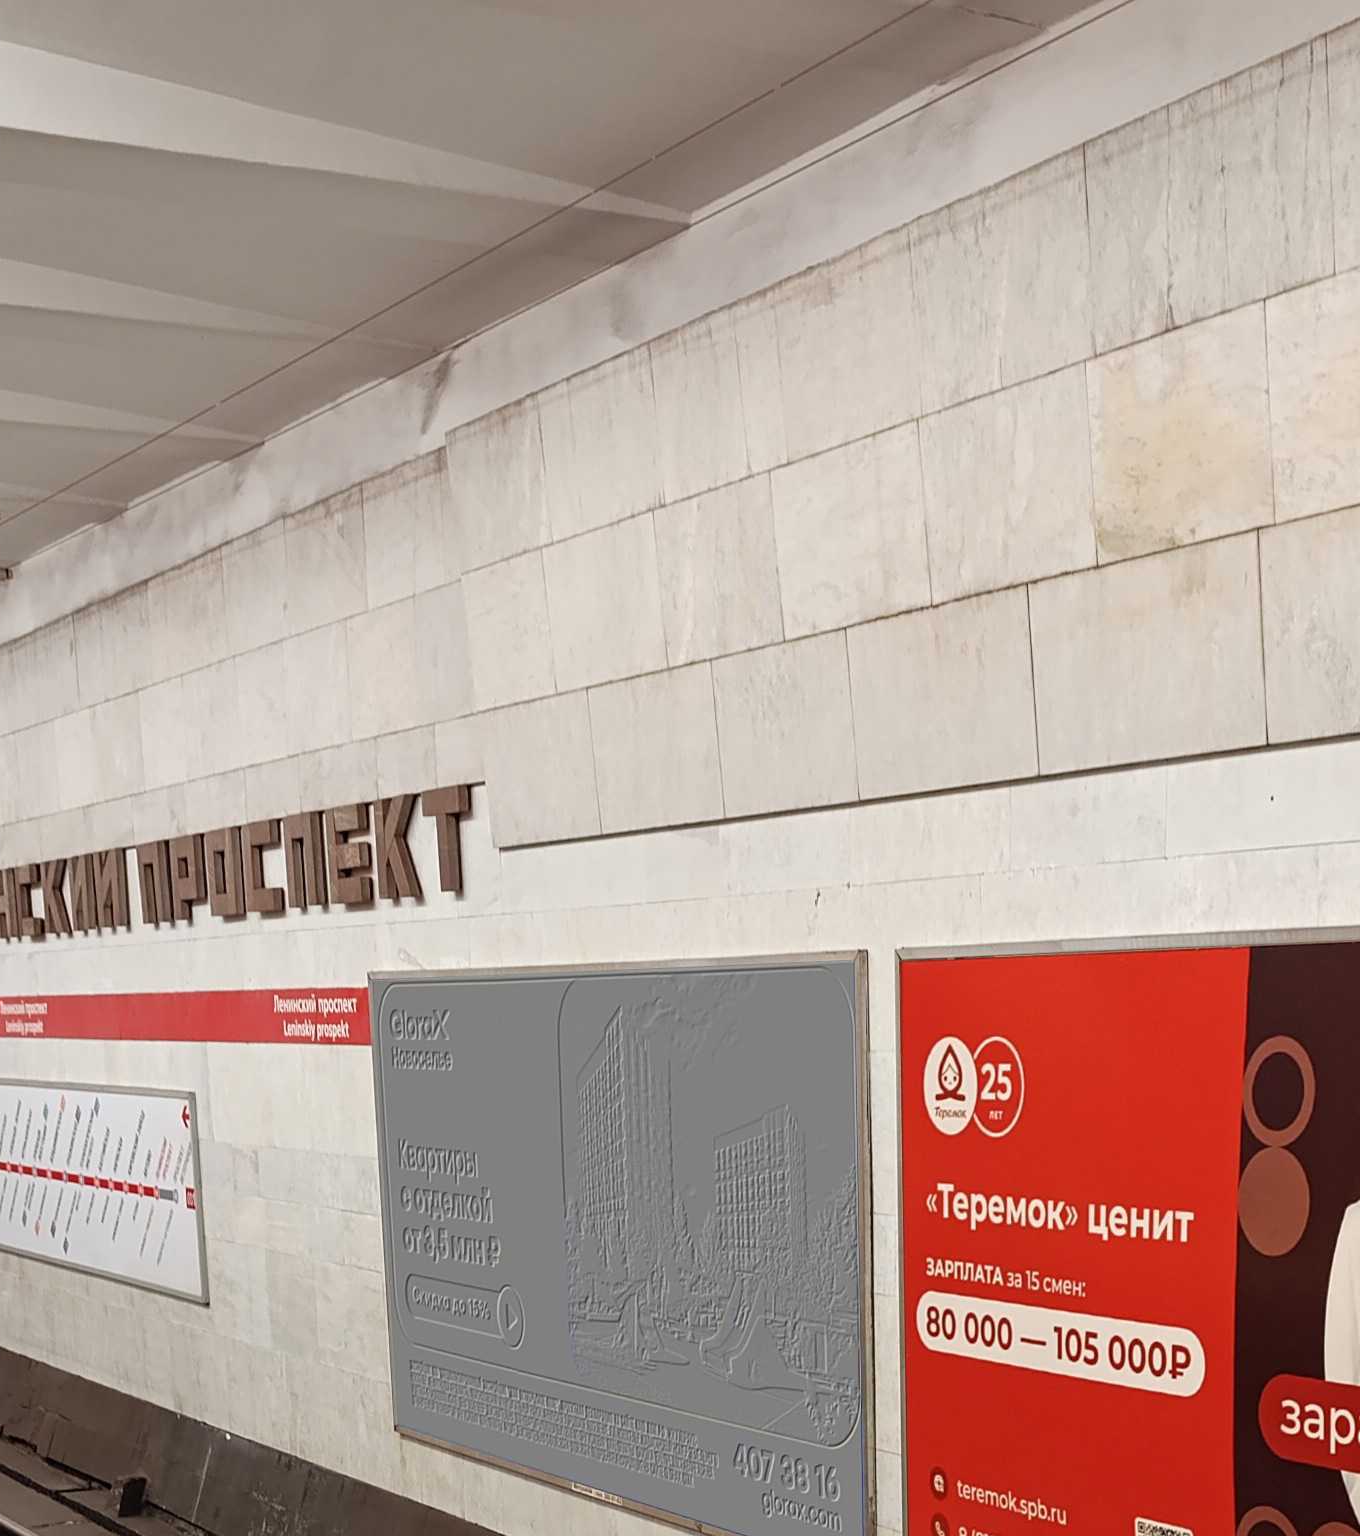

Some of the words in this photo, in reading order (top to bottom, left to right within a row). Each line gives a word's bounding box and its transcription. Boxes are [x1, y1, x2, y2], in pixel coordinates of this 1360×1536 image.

[137, 784, 471, 929] ПРОСПЕКТ
[980, 1063, 1013, 1101] 25
[398, 1138, 479, 1184] Квартиры
[414, 1186, 495, 1224] отделкой
[926, 1183, 1078, 1231] «Теремок»
[1088, 1204, 1194, 1243] ценит
[403, 1227, 422, 1254] от
[451, 1235, 486, 1266] млн
[926, 1257, 1003, 1286] ЗАРПЛАТА
[1006, 1272, 1022, 1288] за
[1025, 1270, 1039, 1291] 15
[1043, 1276, 1086, 1298] смен:
[452, 1297, 466, 1317] до
[926, 1306, 956, 1339] 80
[964, 1312, 1013, 1351] 000
[1053, 1325, 1099, 1366] 105
[733, 1443, 775, 1484] 407
[780, 1454, 810, 1494] 38
[814, 1463, 841, 1502] 16
[761, 1489, 842, 1532] glorax.com
[957, 1480, 1067, 1525] teremok.spb.ru
